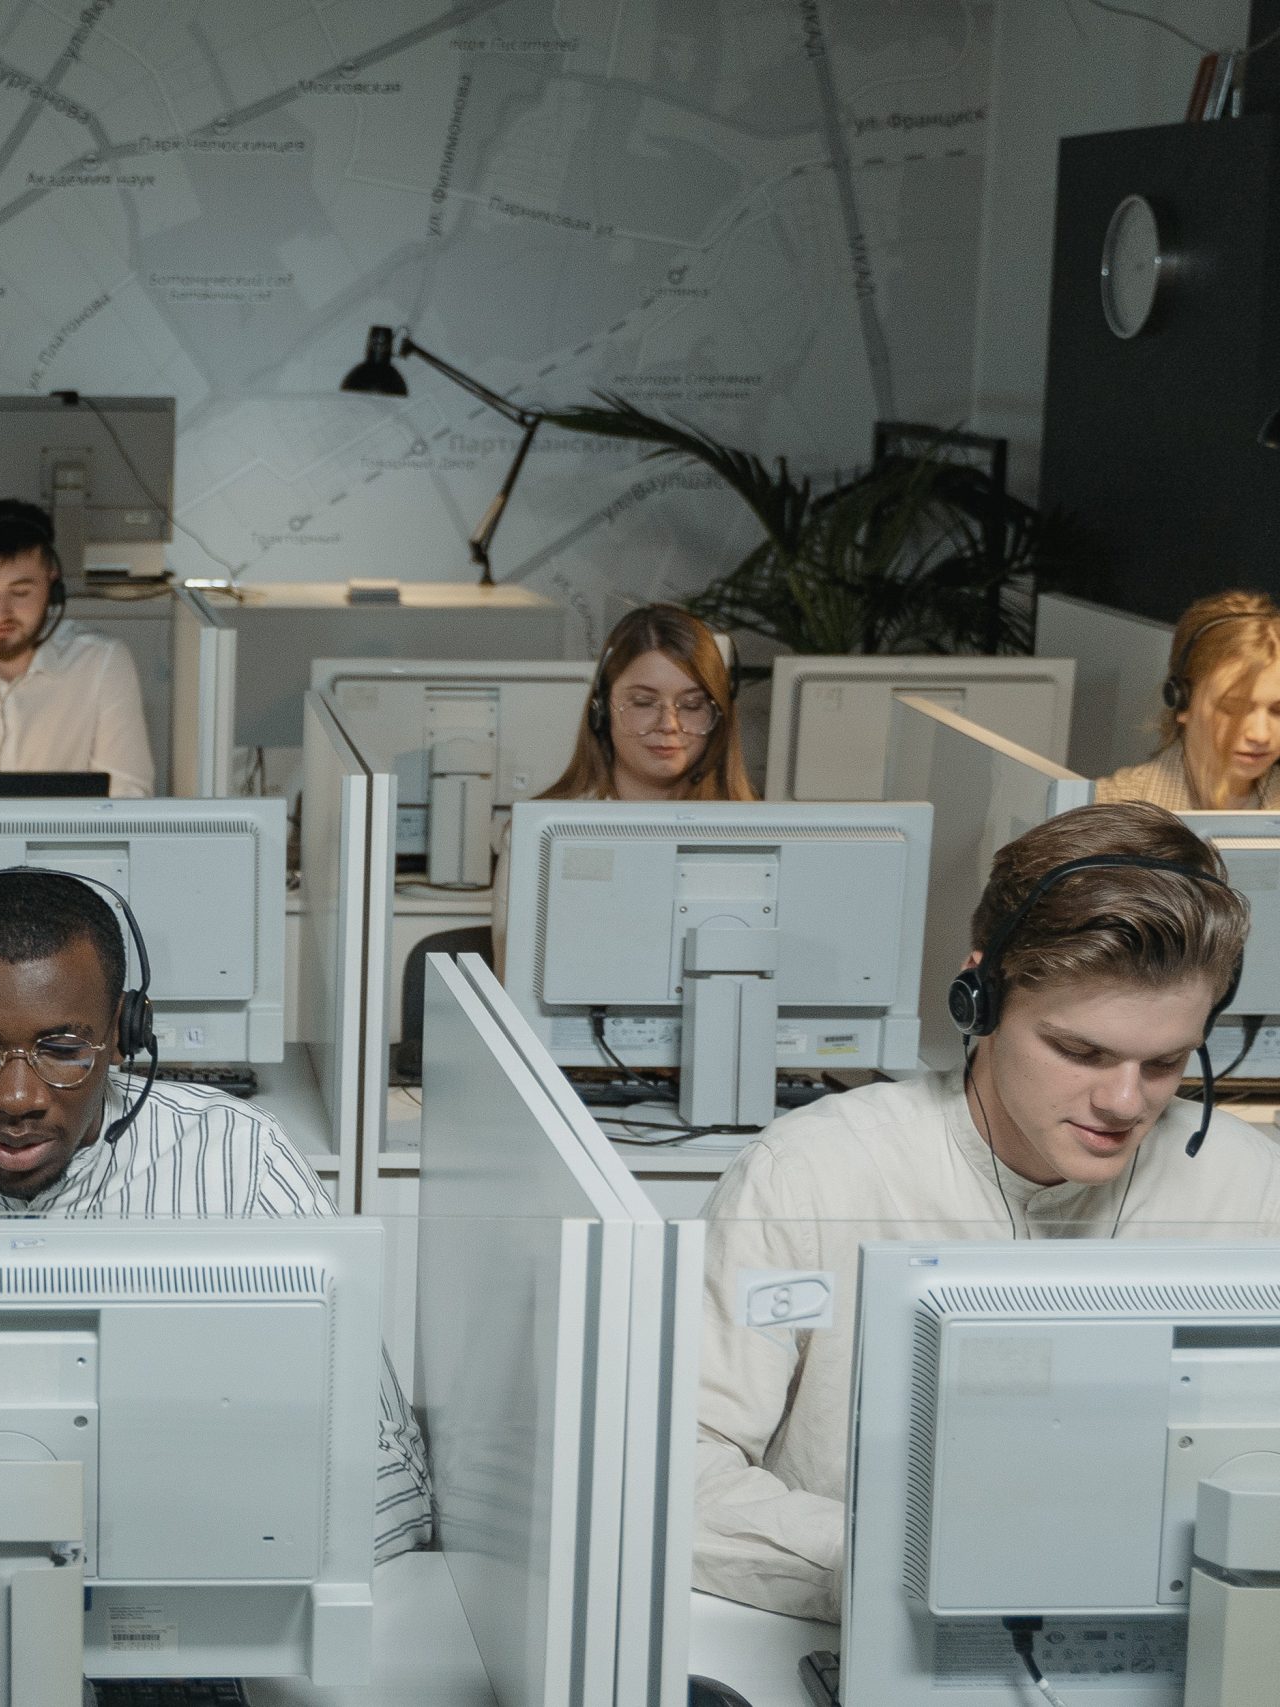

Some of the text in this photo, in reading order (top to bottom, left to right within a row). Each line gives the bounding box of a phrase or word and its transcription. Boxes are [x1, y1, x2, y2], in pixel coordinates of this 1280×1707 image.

[298, 79, 402, 96] Московская
[138, 136, 179, 154] Парк
[431, 74, 472, 204] Филимонова
[26, 171, 156, 191] Академия наук
[149, 272, 263, 288] Ботанический
[771, 1286, 792, 1319] 8
